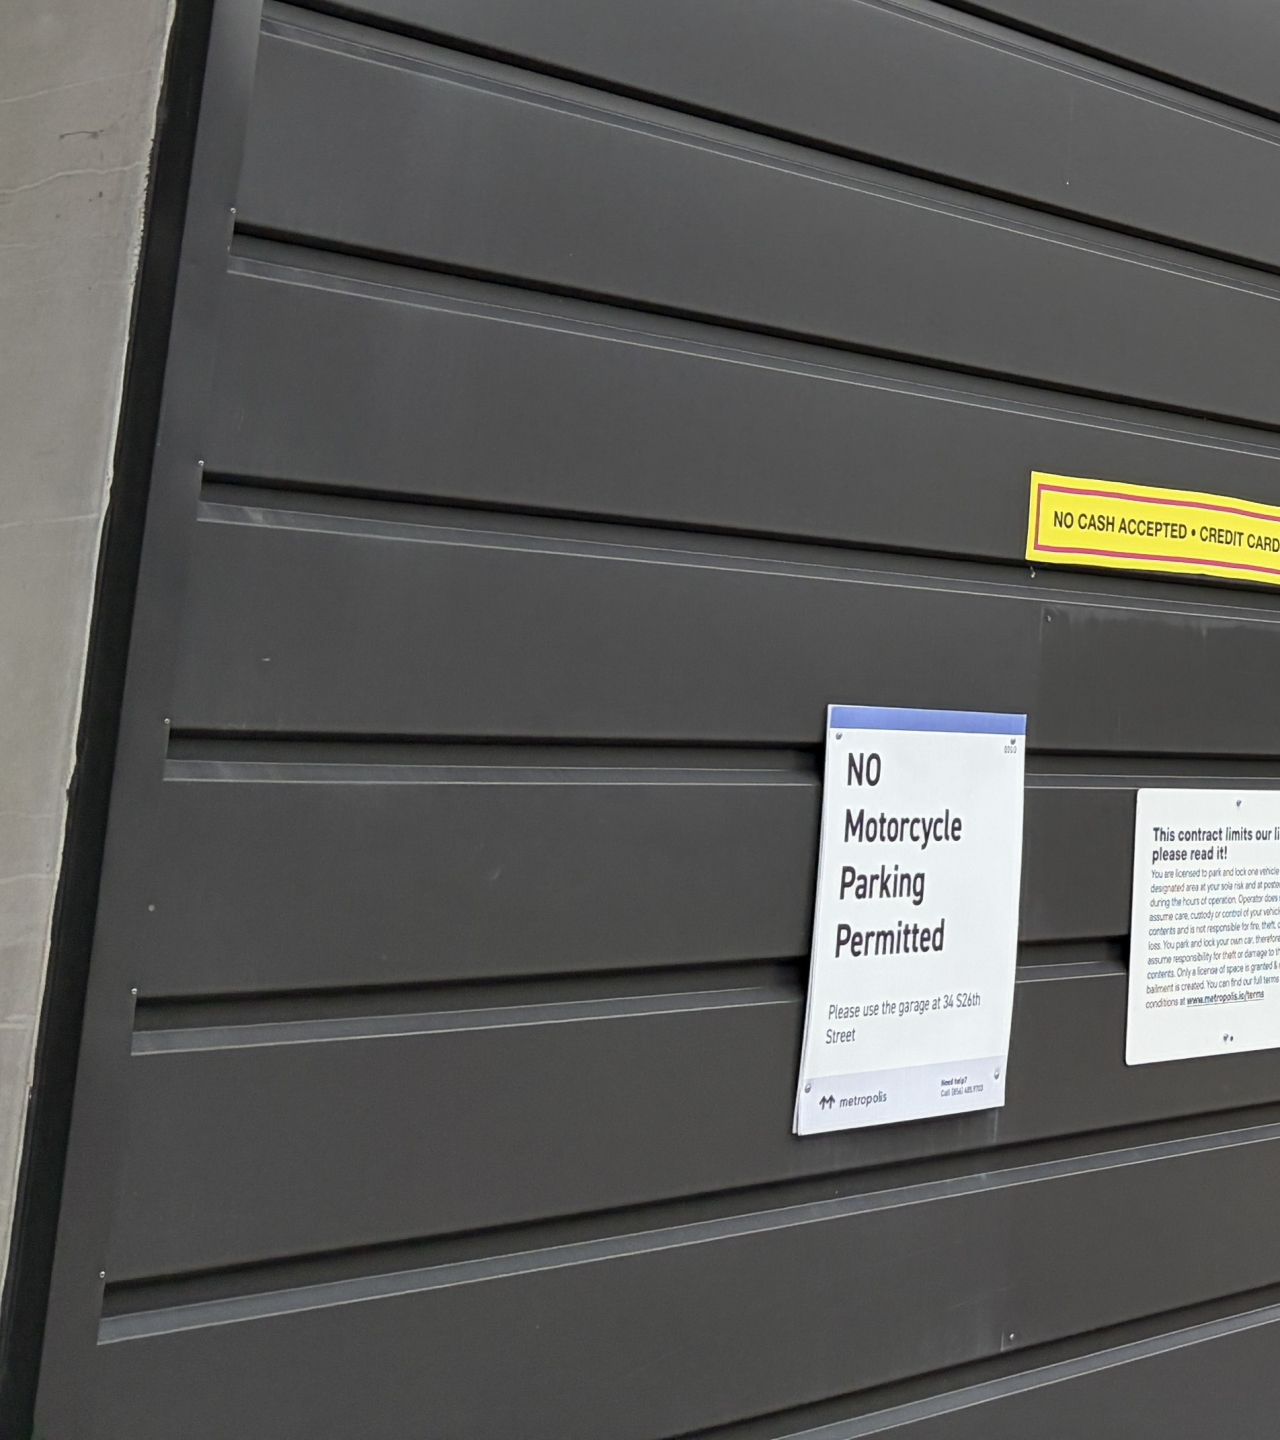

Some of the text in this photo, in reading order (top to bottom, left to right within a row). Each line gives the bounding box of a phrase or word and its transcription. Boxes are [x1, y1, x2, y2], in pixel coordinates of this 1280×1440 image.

[1054, 511, 1074, 529] NO
[1078, 514, 1115, 532] CASH
[1118, 518, 1187, 539] ACCEPTED
[1200, 527, 1244, 547] CREDIT
[847, 752, 881, 787] NO
[844, 809, 963, 849] Motorcycle
[1153, 828, 1175, 841] This
[1178, 828, 1222, 841] contract
[1226, 827, 1252, 841] limits
[1256, 830, 1272, 841] our
[1152, 846, 1227, 864] please read it!
[839, 864, 925, 906] Parking
[835, 918, 945, 958] Permitted
[828, 993, 981, 1020] Please use the garage at 34 S26th
[825, 1029, 856, 1044] Street
[839, 1091, 888, 1109] metropolis
